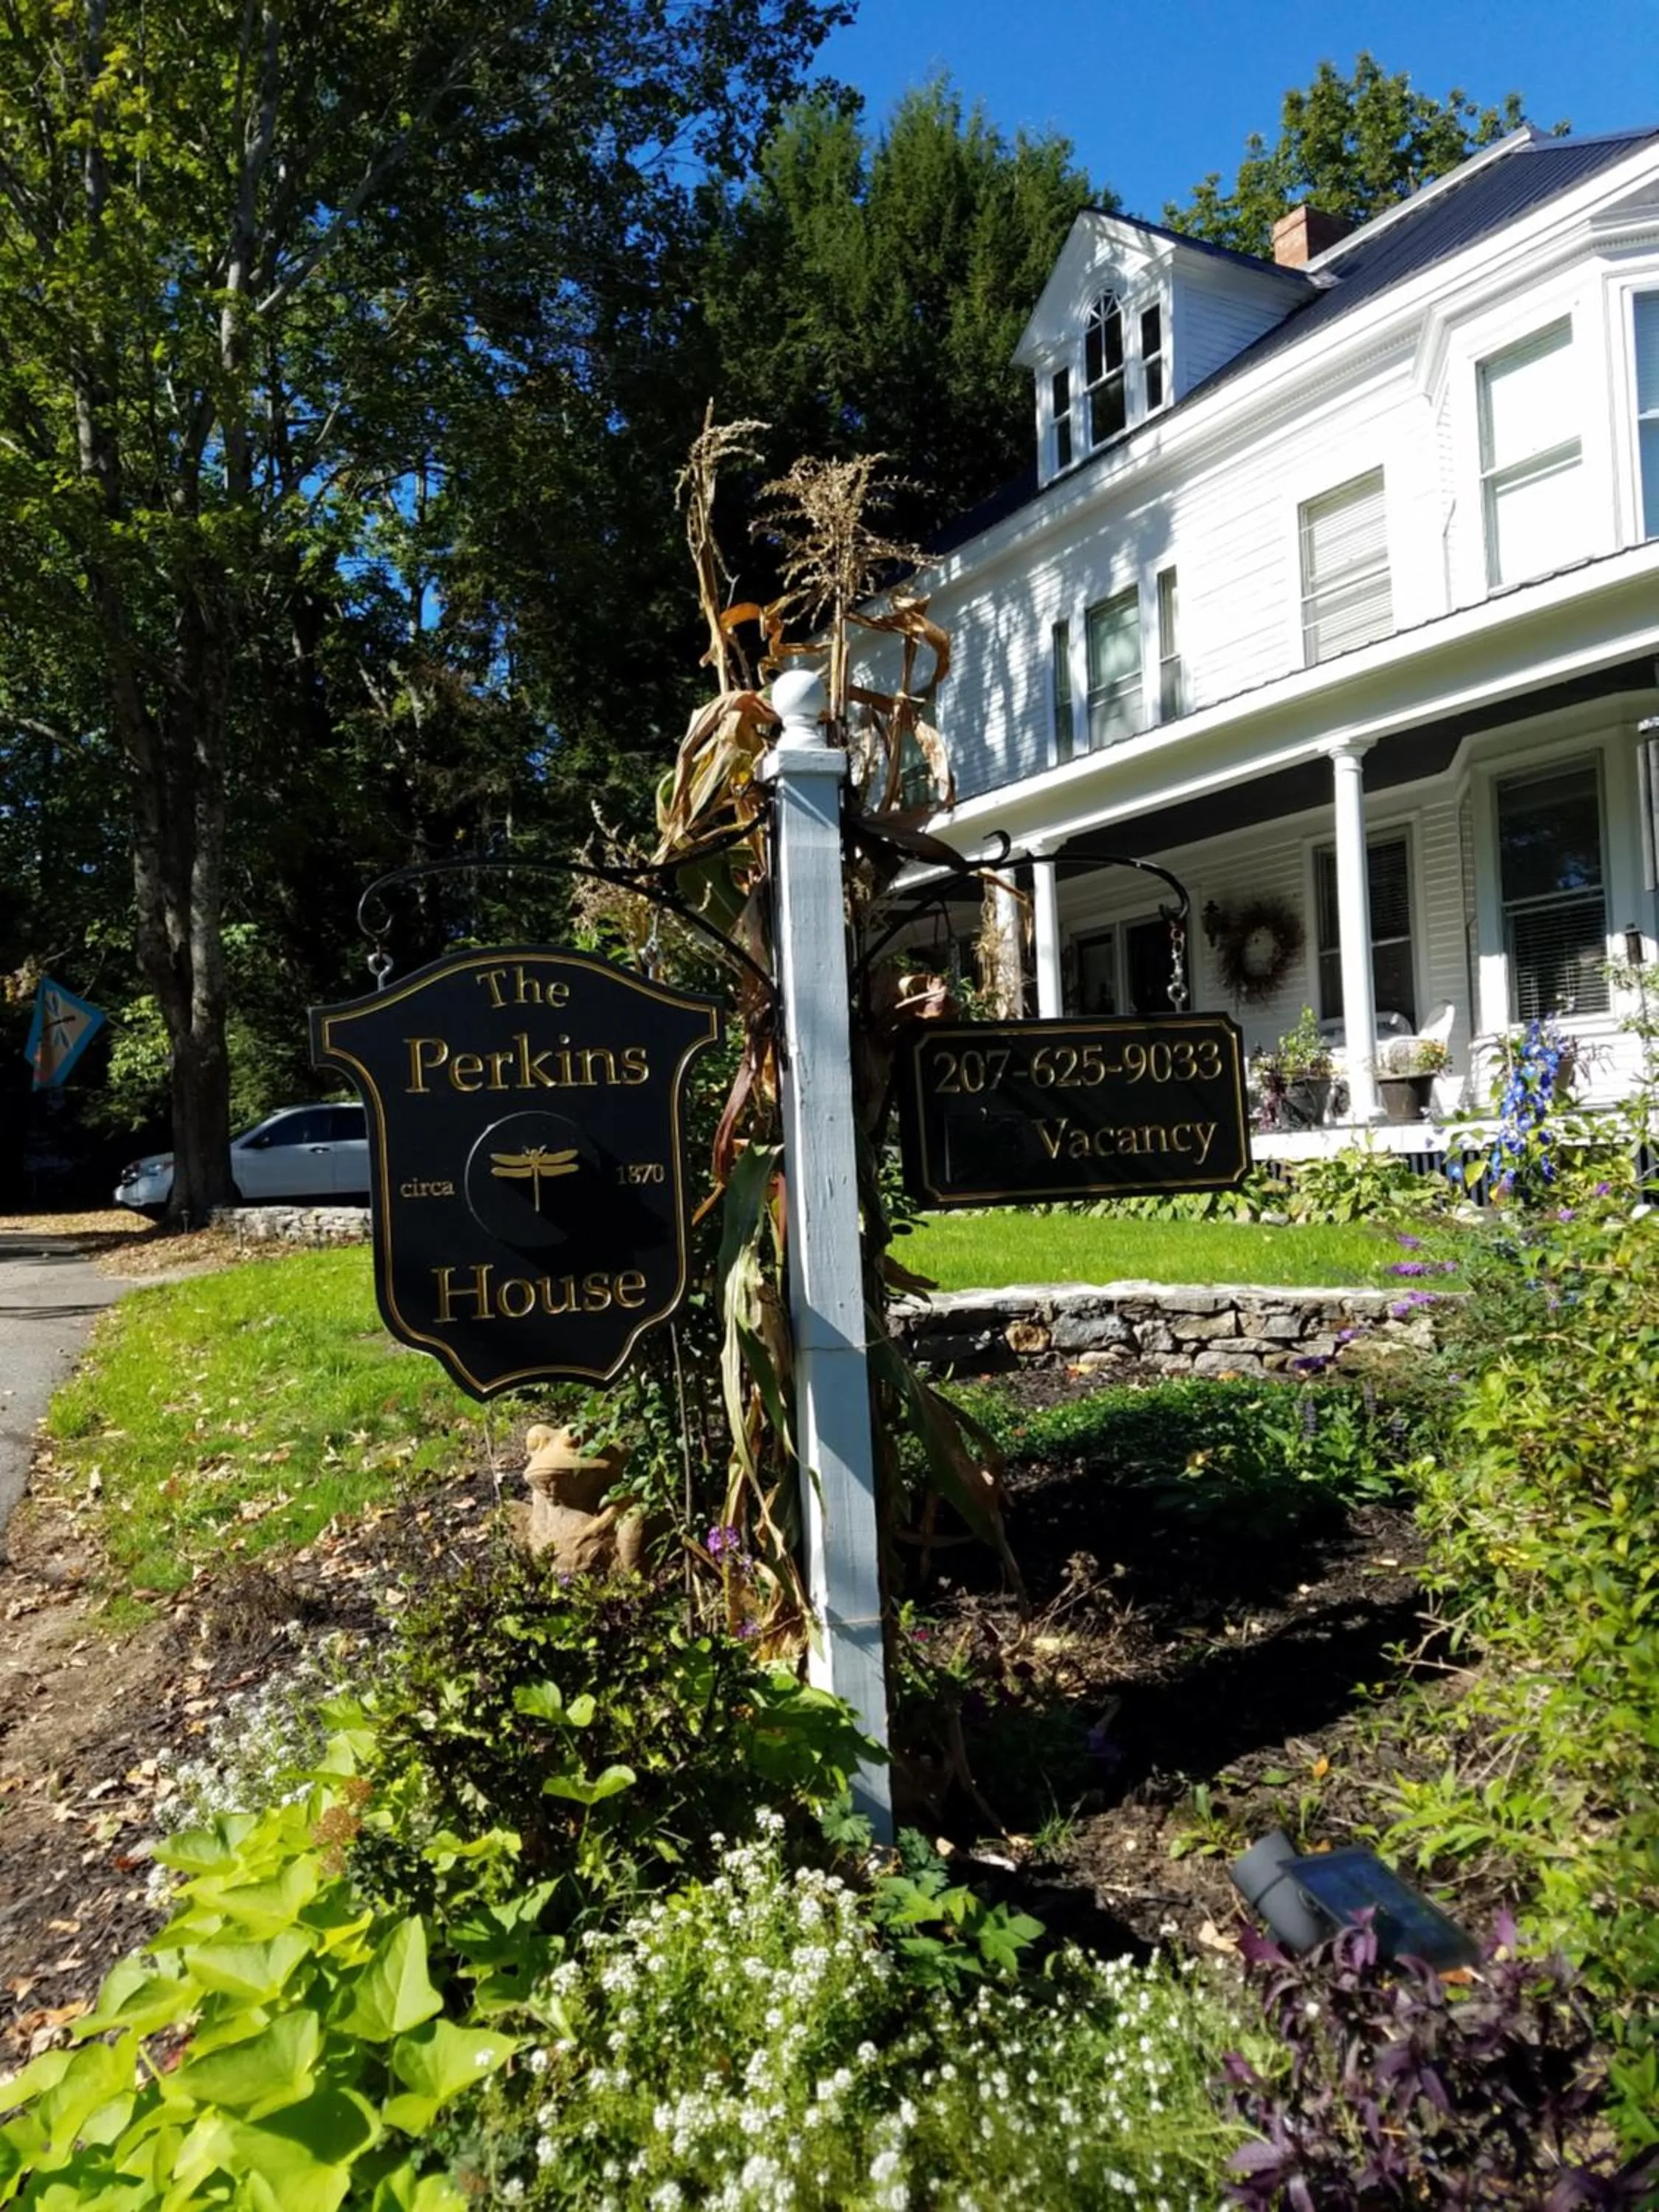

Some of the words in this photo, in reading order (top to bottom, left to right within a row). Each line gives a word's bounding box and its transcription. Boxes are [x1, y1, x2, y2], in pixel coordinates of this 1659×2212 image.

[476, 966, 571, 1009] The
[403, 1034, 650, 1093] Perkins
[933, 1040, 1223, 1094] 207-625-9033
[1034, 1117, 1218, 1165] Vacancy
[400, 1178, 455, 1198] circa
[432, 1263, 647, 1324] House
